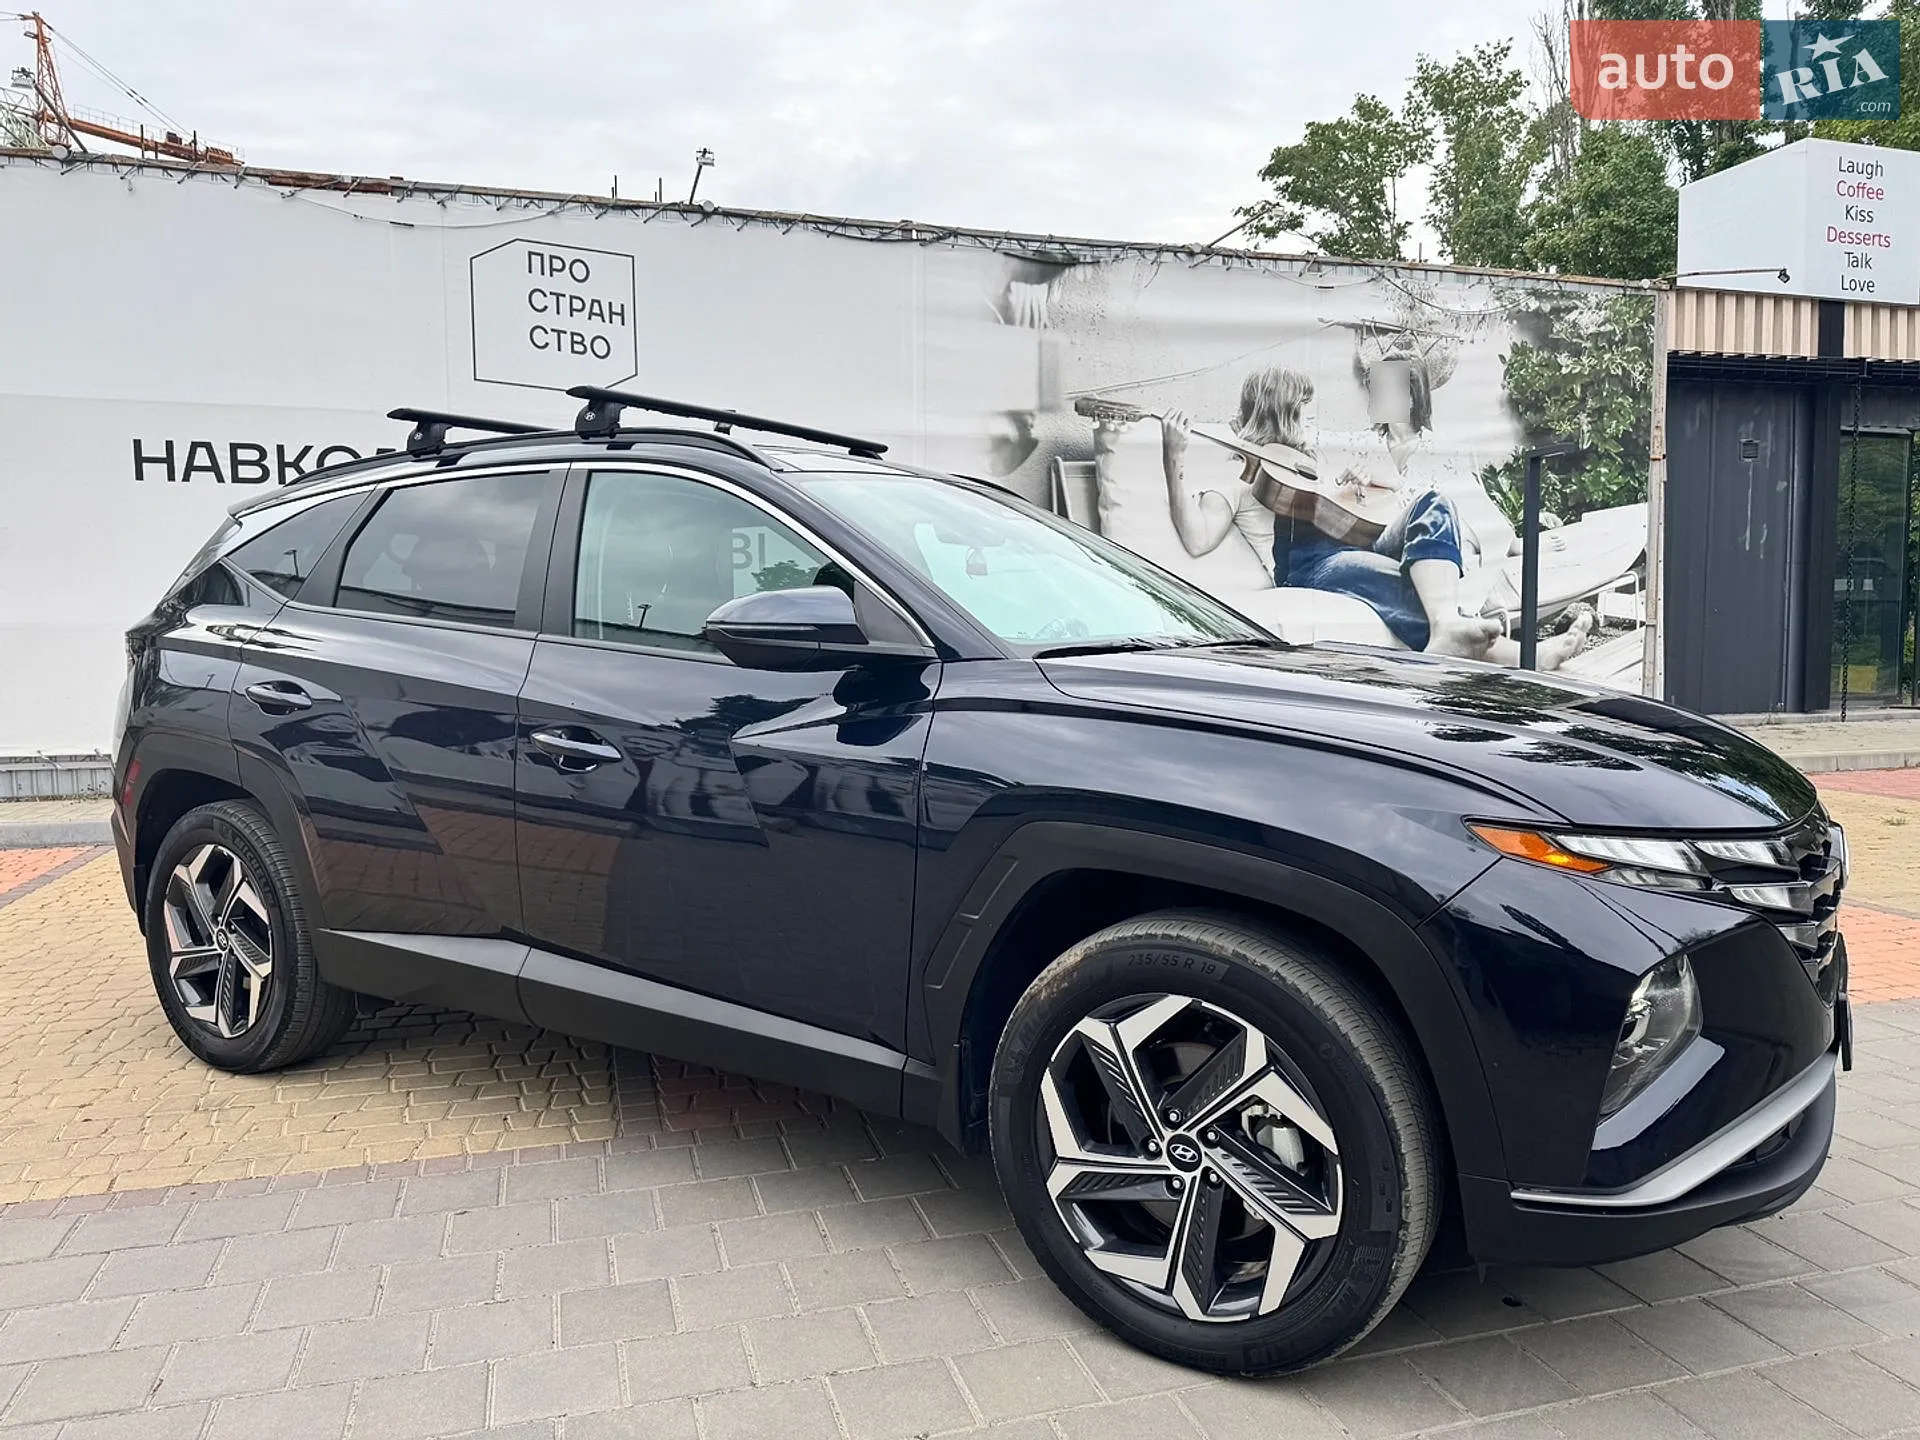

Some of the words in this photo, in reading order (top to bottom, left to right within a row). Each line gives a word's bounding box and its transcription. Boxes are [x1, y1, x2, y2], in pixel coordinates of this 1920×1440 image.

[1838, 156, 1884, 180] Laugh
[1836, 180, 1884, 200] Coffee
[1845, 204, 1874, 223] Kiss
[1826, 226, 1891, 248] Desserts
[527, 250, 590, 283] ПРО
[1844, 251, 1872, 270] Talk
[1841, 274, 1875, 293] Love
[528, 288, 625, 326] СТРАН
[529, 325, 611, 360] СТВО
[1128, 954, 1178, 968] 235/55
[1183, 958, 1195, 969] R
[1200, 962, 1216, 975] 19
